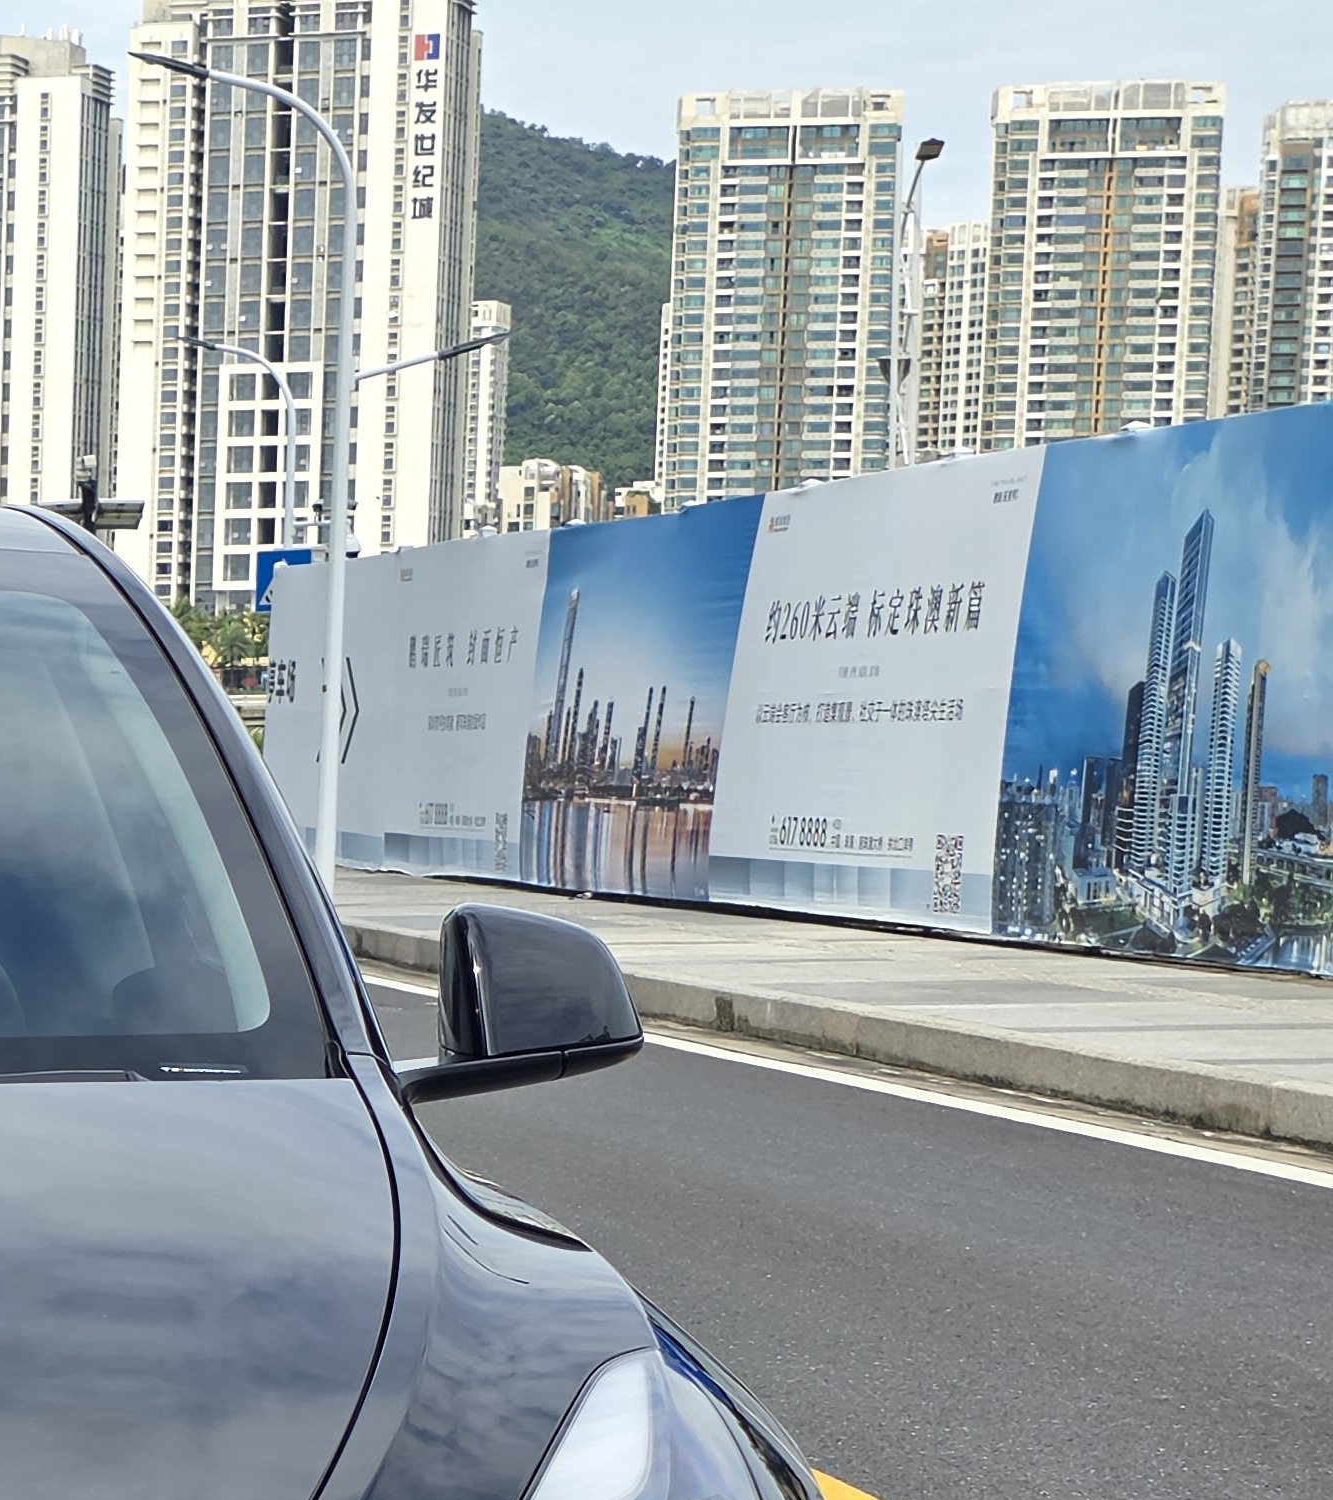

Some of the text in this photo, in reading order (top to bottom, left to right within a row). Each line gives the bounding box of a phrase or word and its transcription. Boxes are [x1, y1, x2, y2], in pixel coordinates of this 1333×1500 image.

[411, 68, 438, 220] 华发世纪城
[764, 581, 986, 645] 约260米云端 标定珠澳新篇
